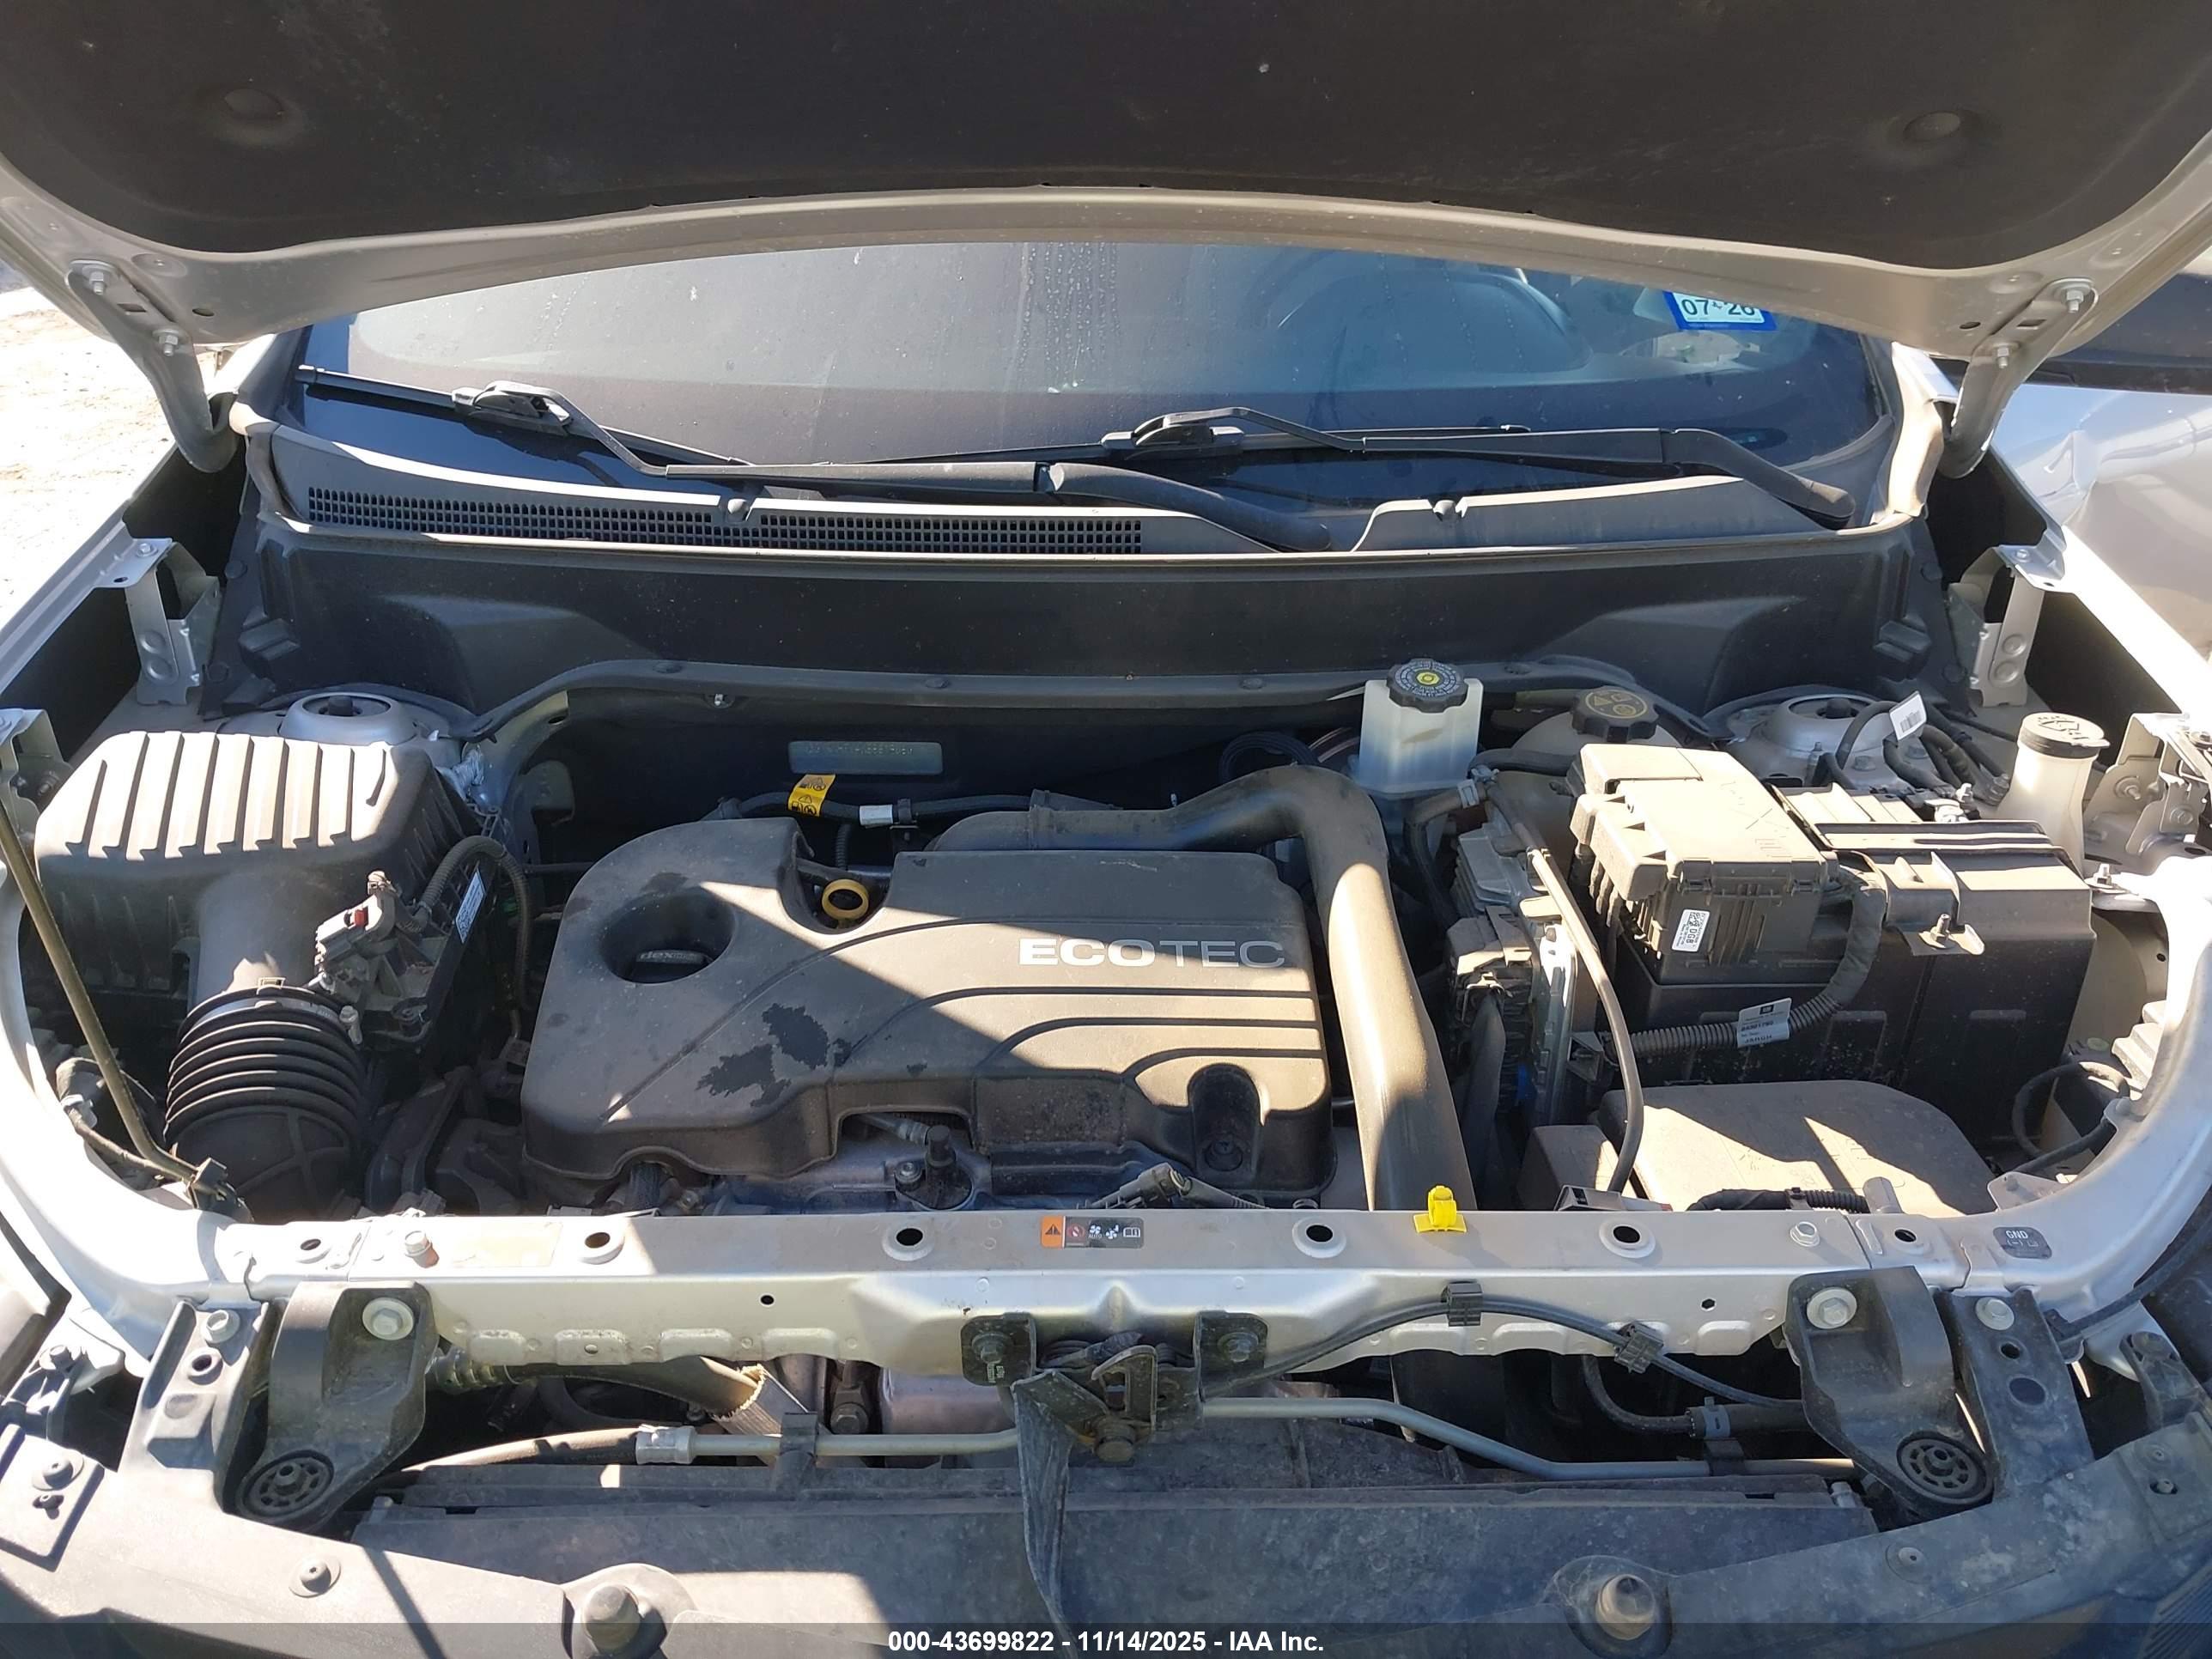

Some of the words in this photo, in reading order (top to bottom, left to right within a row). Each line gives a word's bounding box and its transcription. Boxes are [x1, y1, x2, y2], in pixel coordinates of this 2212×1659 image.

[1680, 299, 1710, 316] 07
[1018, 939, 1285, 969] ECOTEC
[2005, 1230, 2029, 1239] GND
